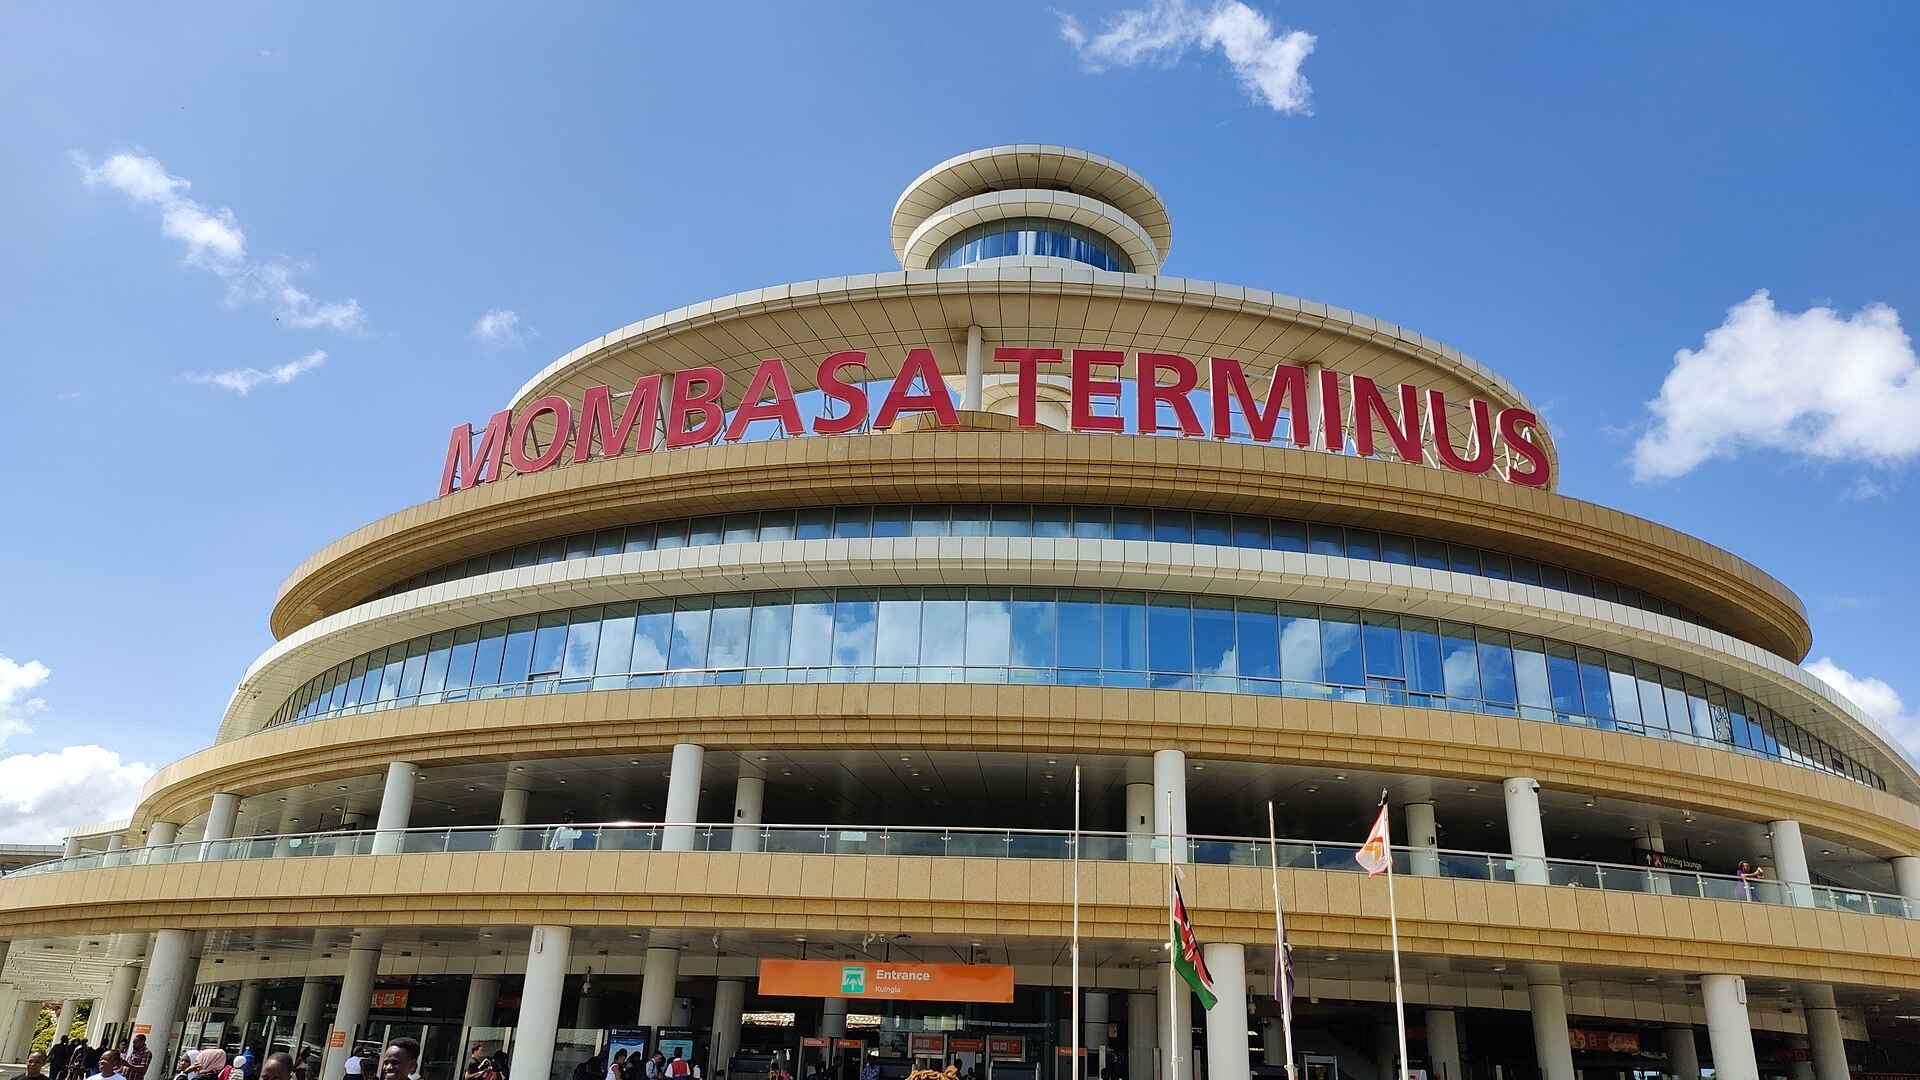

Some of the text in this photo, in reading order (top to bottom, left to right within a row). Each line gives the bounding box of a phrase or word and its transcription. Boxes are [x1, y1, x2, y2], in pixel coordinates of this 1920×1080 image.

[439, 347, 1552, 497] MOMBASA TERMINUS
[1663, 855, 1683, 867] Waiting
[1683, 859, 1702, 870] Lounge
[876, 969, 930, 981] Entrance
[875, 985, 901, 993] Kuingia
